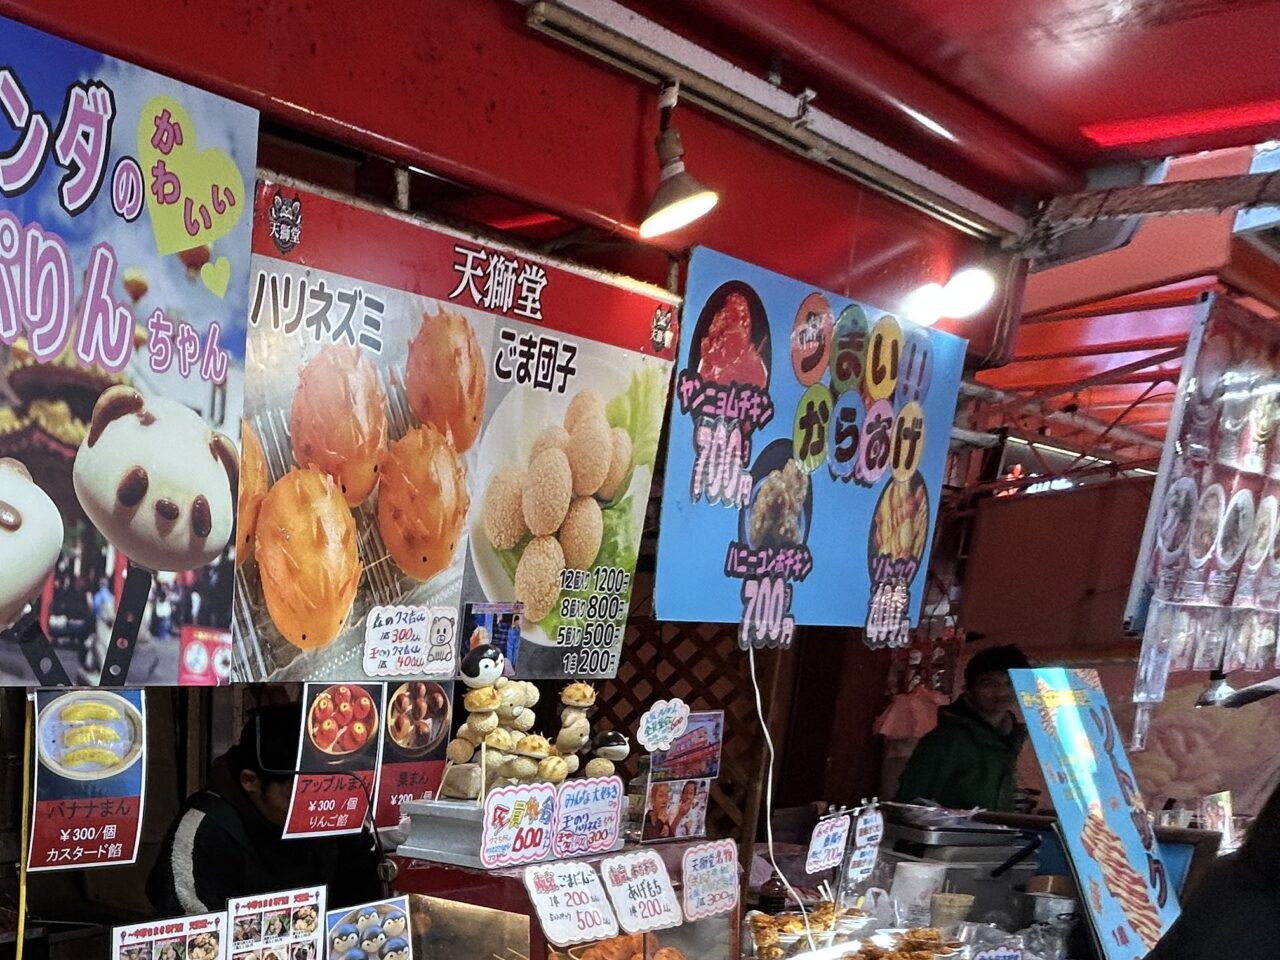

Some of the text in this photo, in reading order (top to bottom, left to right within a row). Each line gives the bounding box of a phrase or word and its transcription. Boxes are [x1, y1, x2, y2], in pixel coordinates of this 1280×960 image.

[151, 108, 236, 236] かわいい
[450, 246, 549, 322] 天獅堂
[250, 271, 386, 353] ハリネズミ
[494, 328, 578, 395] ごま団子
[678, 374, 773, 425] ヤンニョムチキン
[798, 400, 925, 474] からあげ
[691, 420, 754, 508] 700円
[593, 566, 630, 593] 1200円
[586, 594, 625, 621] 800円
[738, 573, 796, 650] 700円
[582, 621, 620, 647] 500円
[577, 648, 616, 674] 200円
[300, 776, 371, 794] アップルまん
[48, 799, 131, 819] バナナまん
[308, 814, 350, 828] りんご餡
[46, 843, 123, 863] カスタード餡
[628, 879, 662, 900] あげもち
